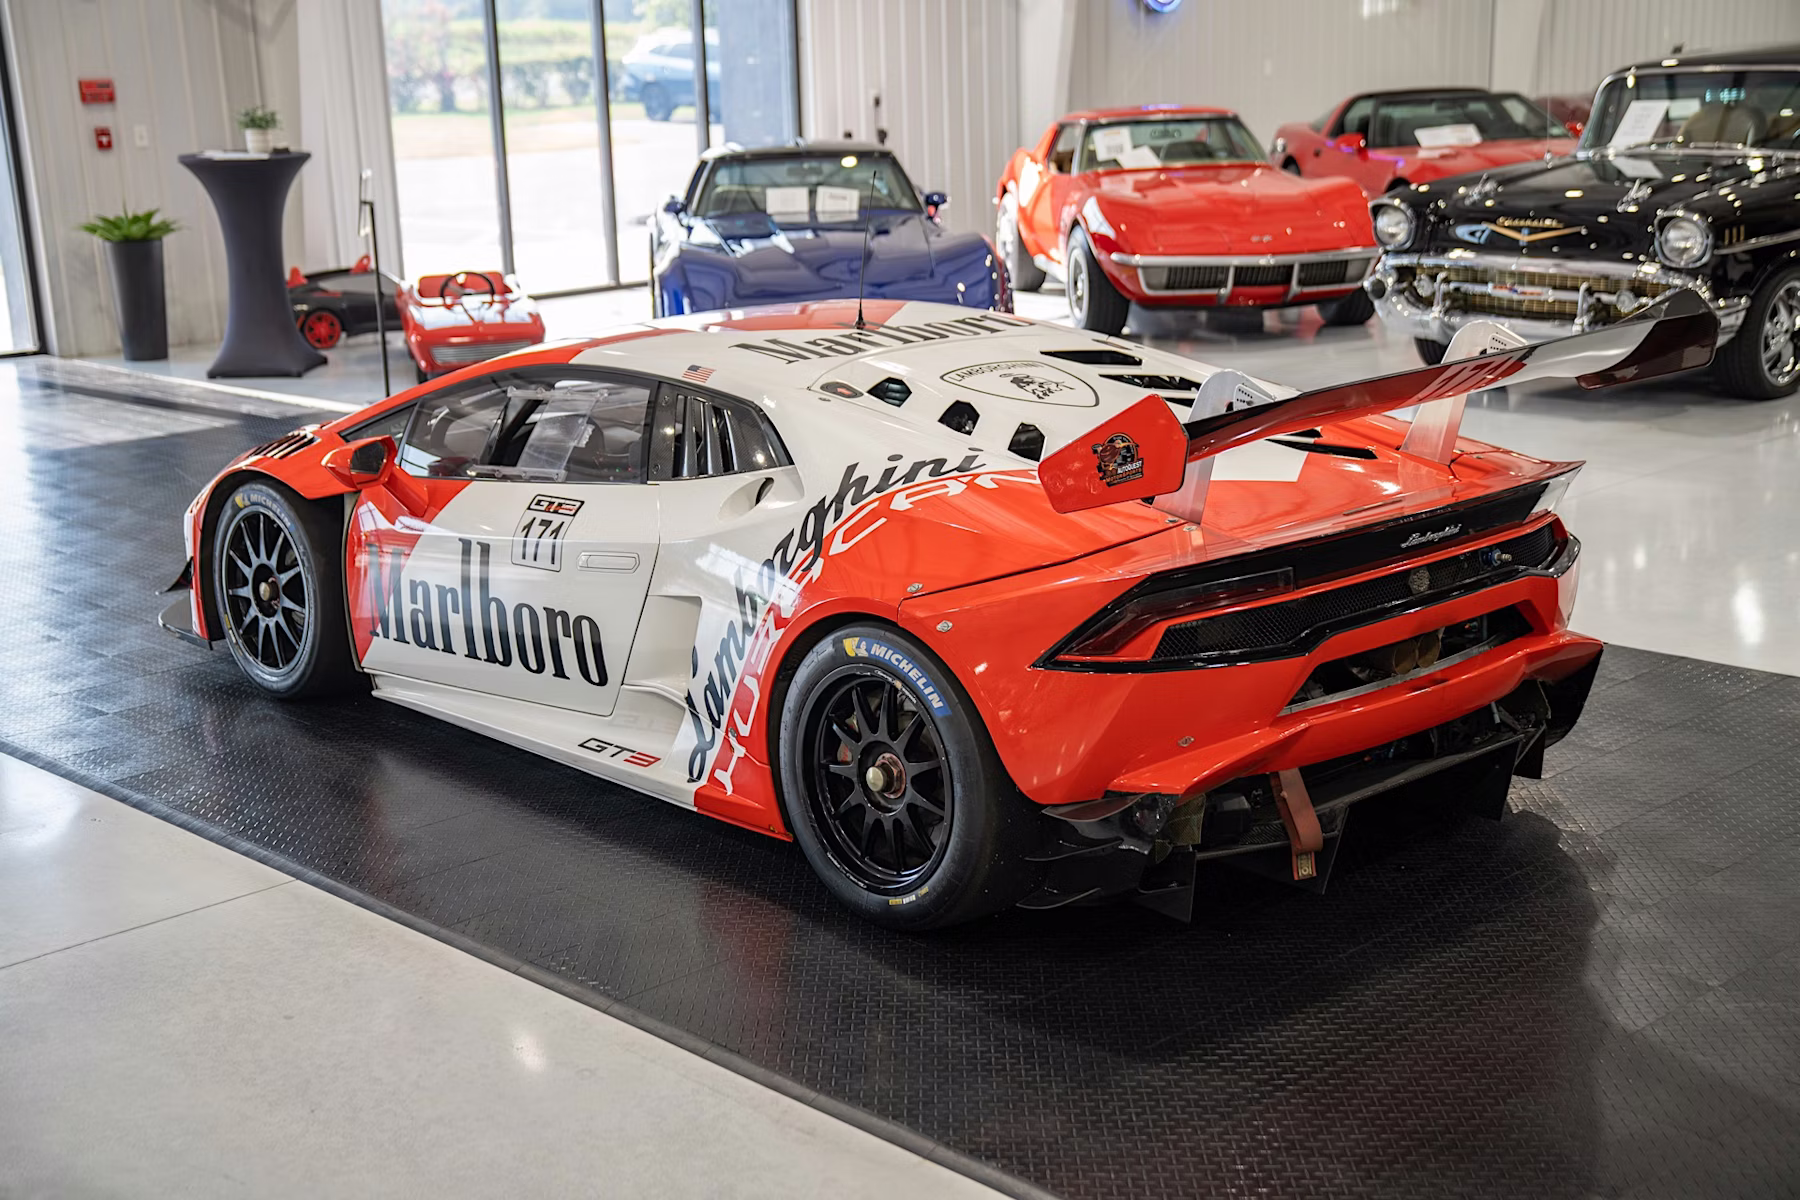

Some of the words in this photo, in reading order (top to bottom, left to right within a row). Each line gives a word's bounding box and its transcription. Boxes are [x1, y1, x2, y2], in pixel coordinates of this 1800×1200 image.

[250, 493, 291, 528] MICHELIN
[520, 515, 566, 566] 171
[365, 537, 609, 687] Marlboro
[686, 446, 987, 784] Lamborghini
[870, 643, 944, 709] MICHELIN
[577, 737, 662, 768] GT3
